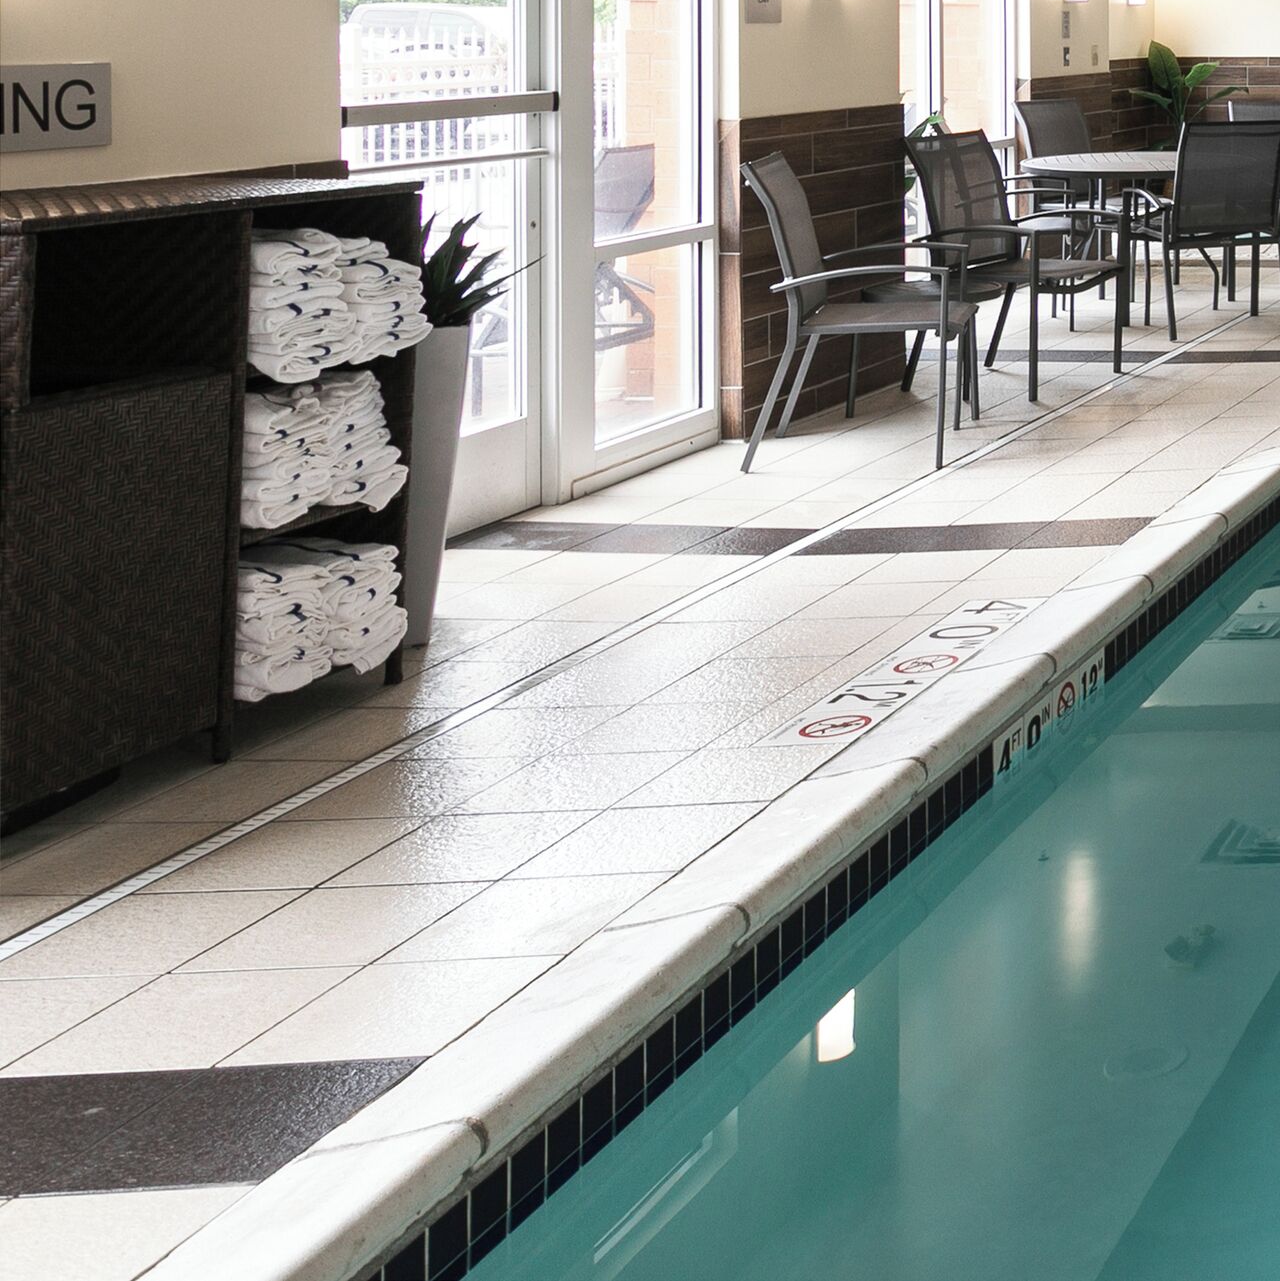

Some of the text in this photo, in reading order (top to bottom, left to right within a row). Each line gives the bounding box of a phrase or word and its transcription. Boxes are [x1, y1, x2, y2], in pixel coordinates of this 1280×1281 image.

[963, 601, 1027, 615] 4
[997, 737, 1012, 775] 4
[1011, 727, 1022, 751] FT
[1041, 703, 1051, 724] IN
